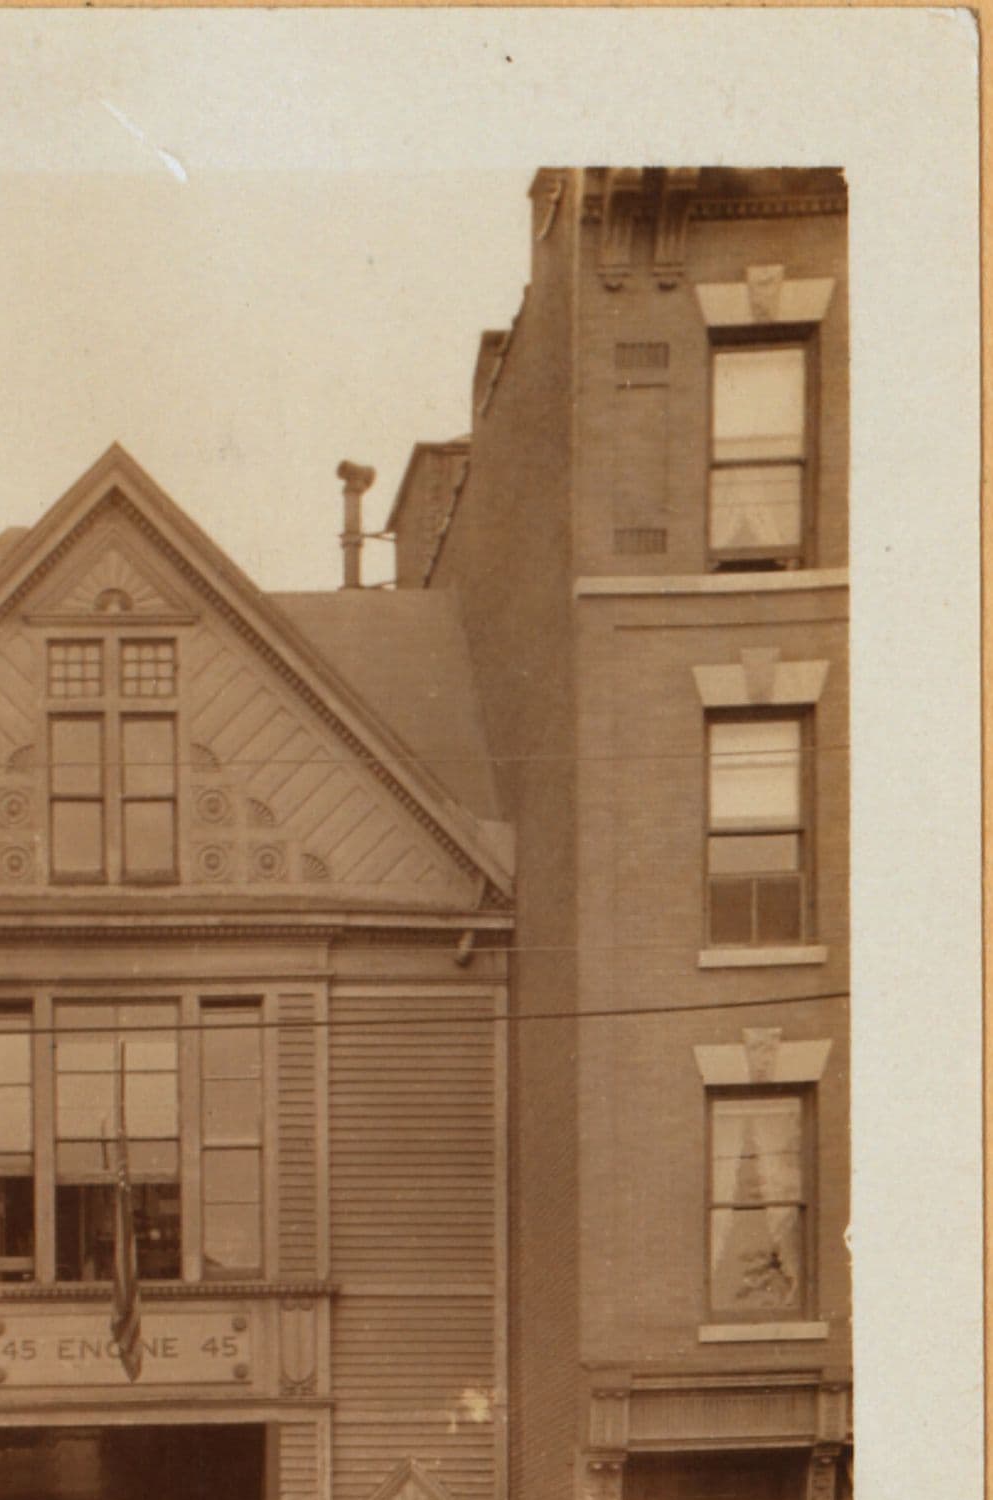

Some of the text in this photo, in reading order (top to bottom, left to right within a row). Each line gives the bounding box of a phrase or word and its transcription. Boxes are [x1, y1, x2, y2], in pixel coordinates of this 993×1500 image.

[2, 1336, 239, 1361] 45 ENGNE 45
